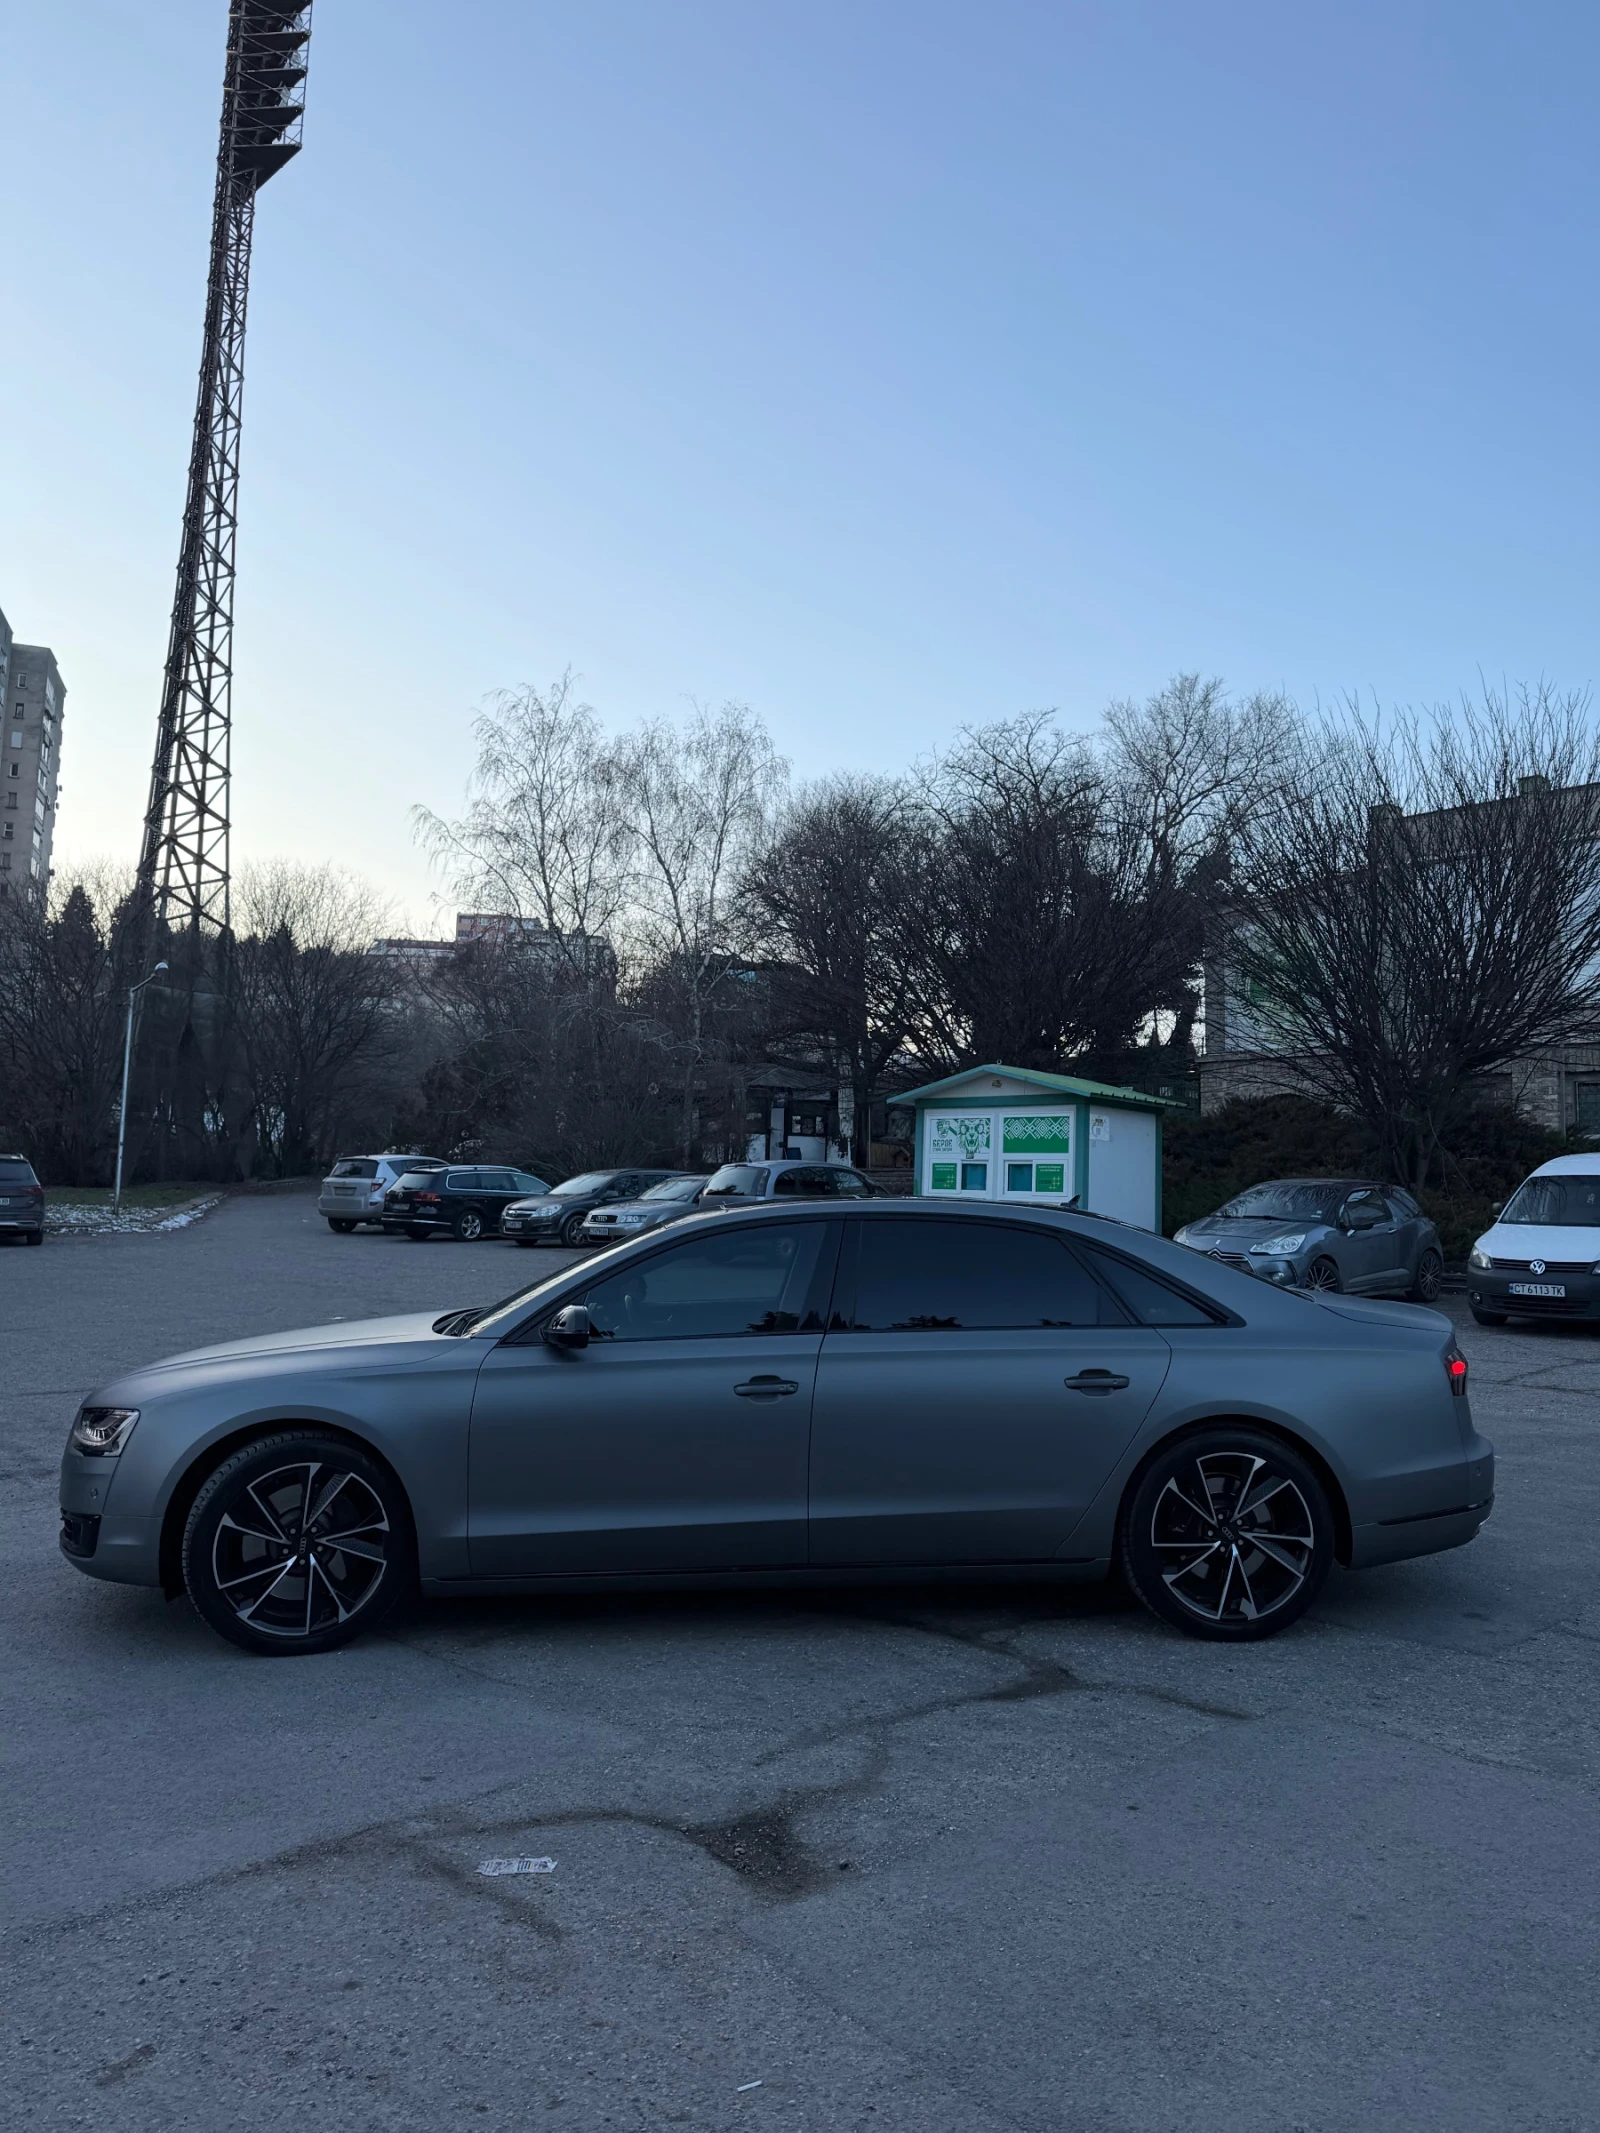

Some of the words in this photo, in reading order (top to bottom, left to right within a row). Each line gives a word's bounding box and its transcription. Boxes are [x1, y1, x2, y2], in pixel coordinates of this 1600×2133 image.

[1514, 1284, 1526, 1294] CT
[1527, 1285, 1550, 1295] 6113
[1551, 1286, 1563, 1296] TK
